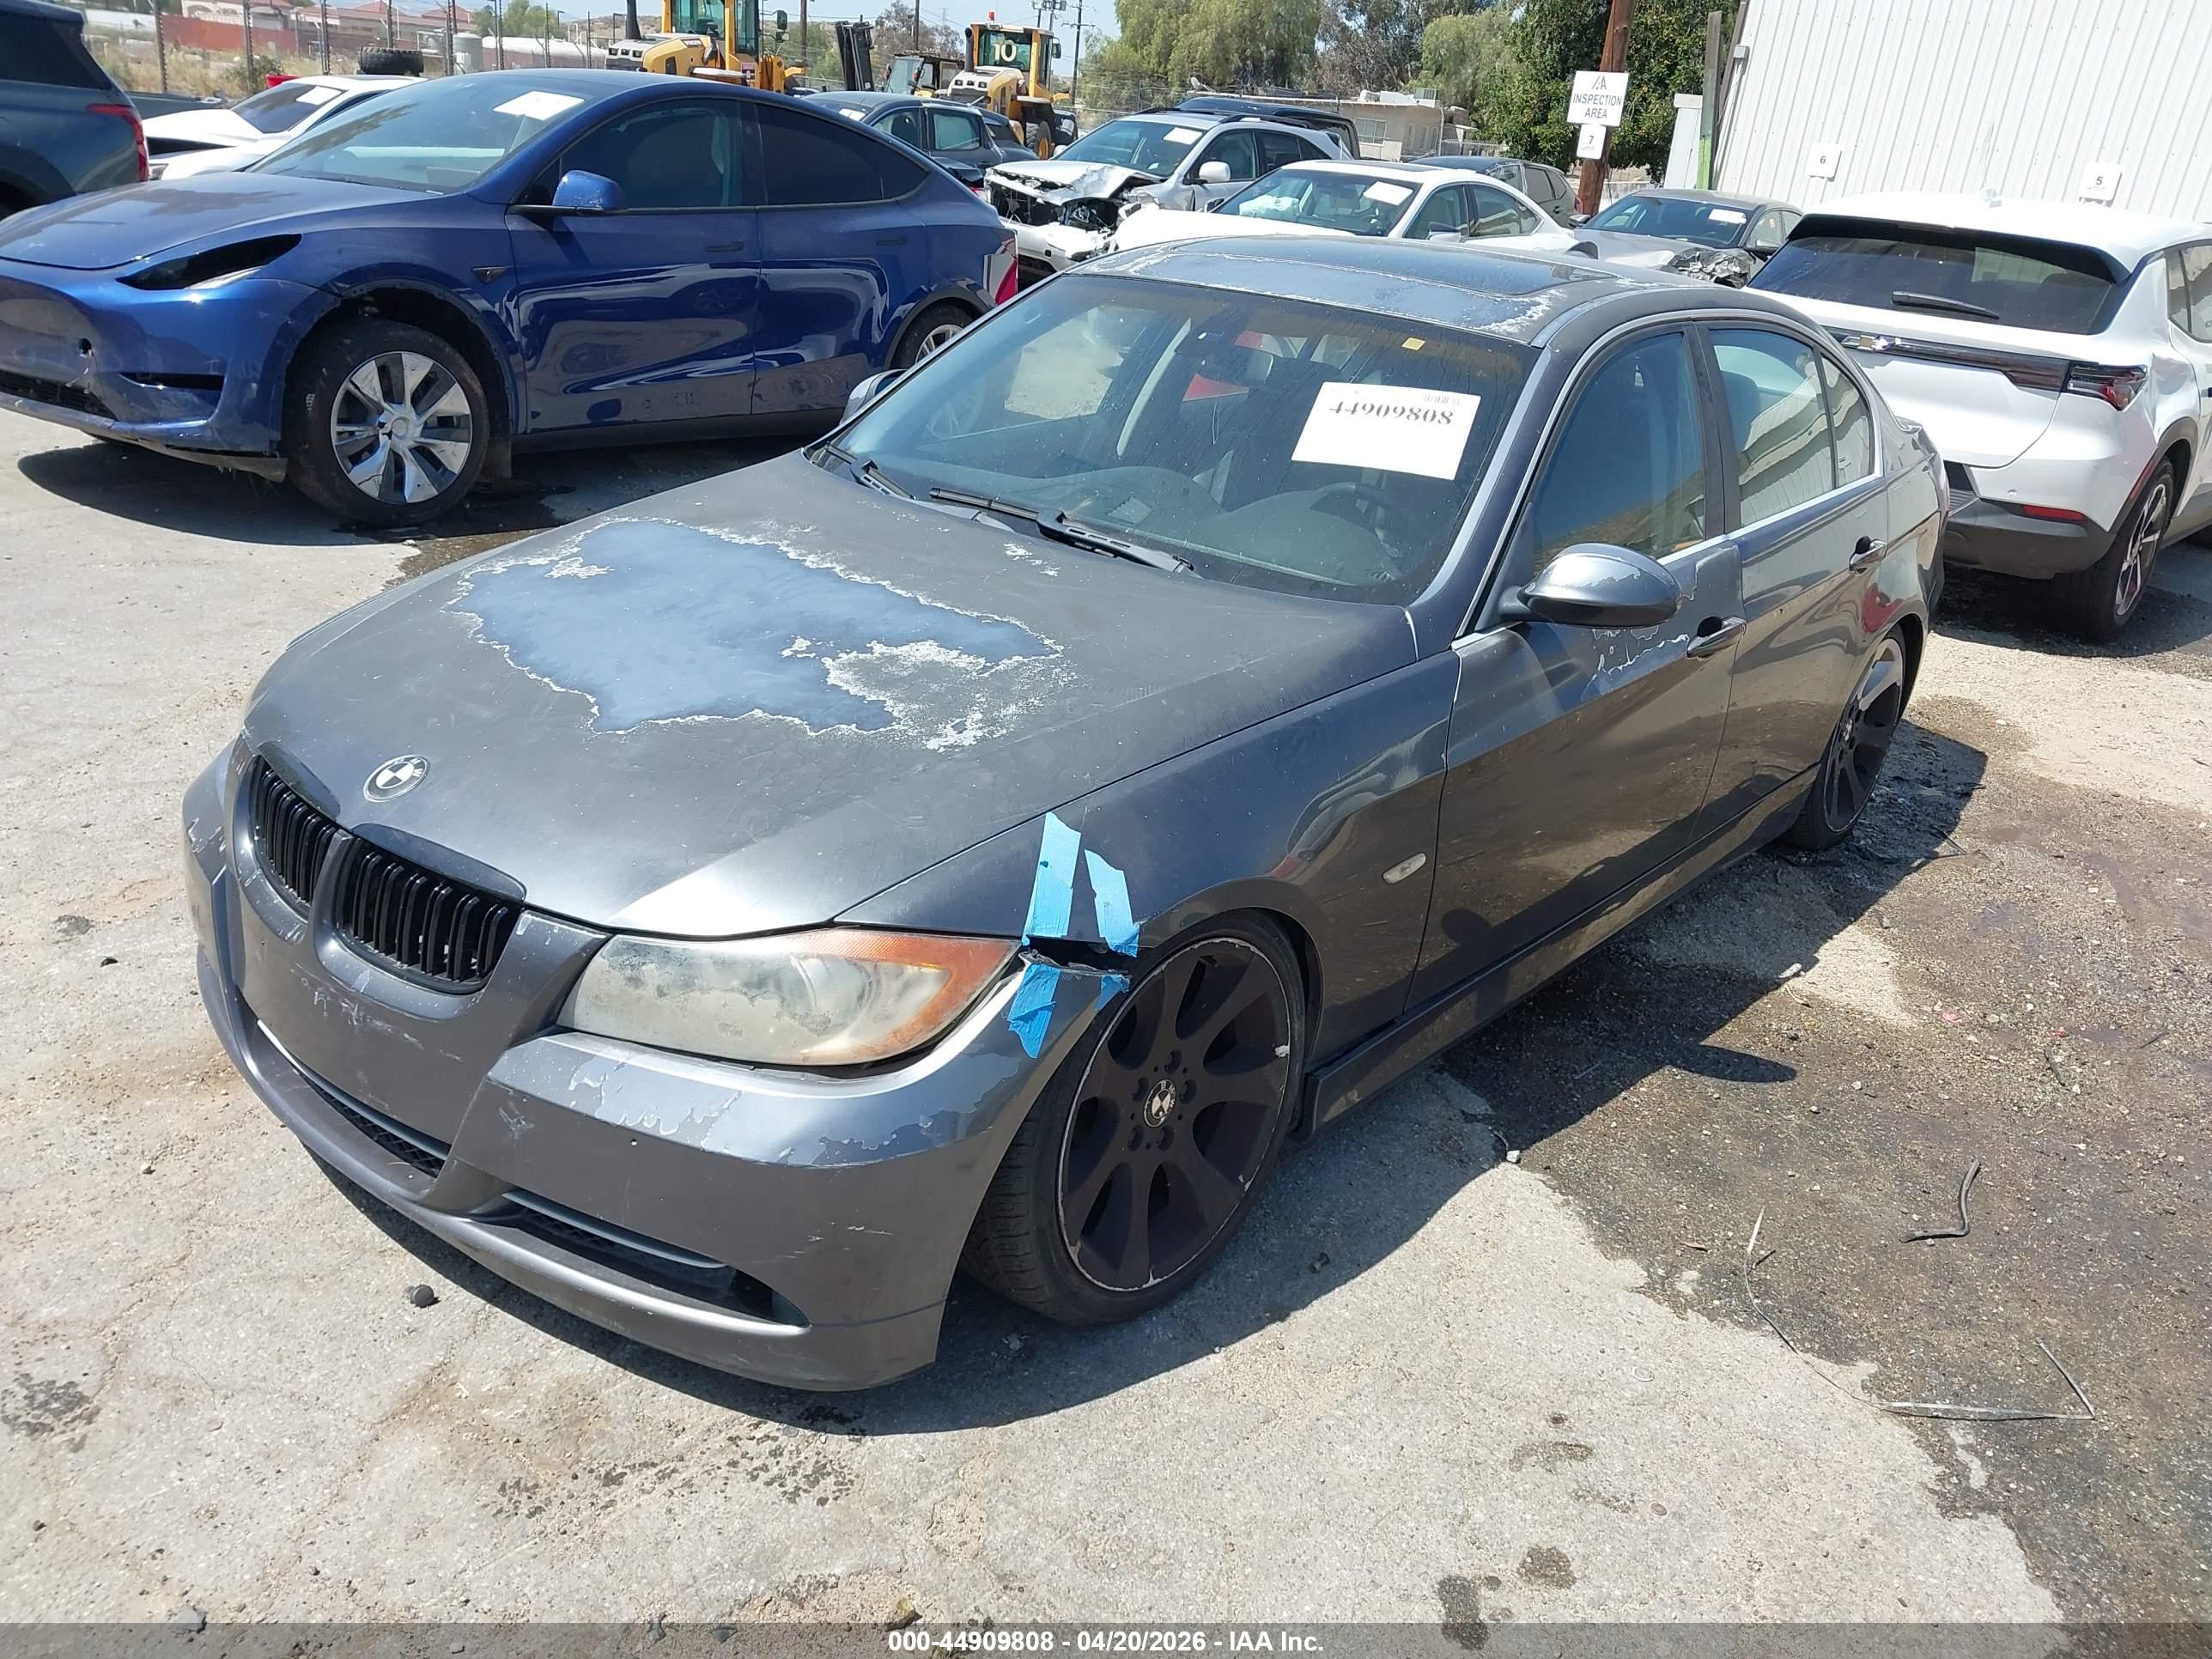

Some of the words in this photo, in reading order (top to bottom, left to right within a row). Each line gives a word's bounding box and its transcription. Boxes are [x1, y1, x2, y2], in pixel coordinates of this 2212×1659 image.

[994, 40, 1017, 62] 10
[1573, 94, 1622, 106] INSPECTION
[1584, 107, 1607, 118] AREA
[1589, 135, 1595, 144] 7
[1820, 155, 1826, 164] 6
[2095, 176, 2104, 185] 5
[1329, 400, 1454, 425] 44909808
